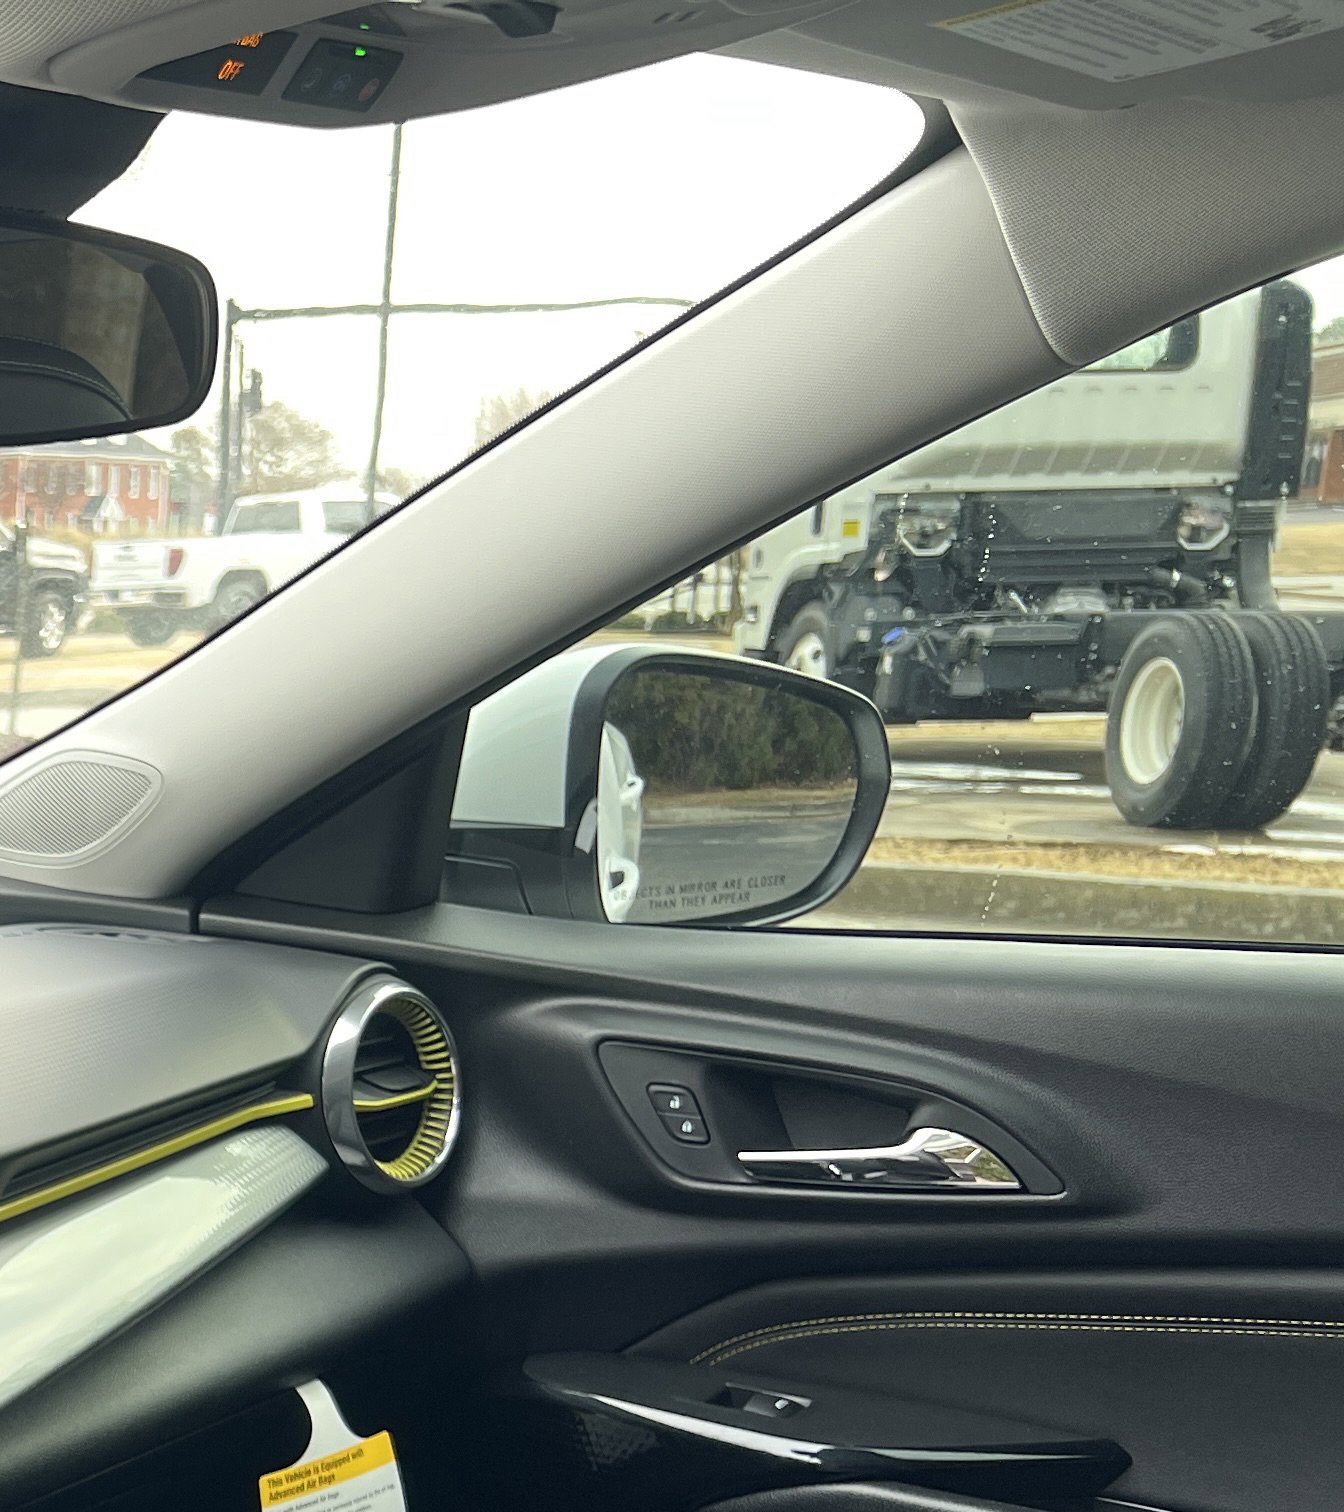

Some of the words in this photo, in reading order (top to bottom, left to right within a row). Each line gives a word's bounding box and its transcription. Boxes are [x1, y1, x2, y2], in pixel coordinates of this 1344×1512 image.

[218, 59, 244, 80] OFF
[665, 885, 675, 896] IN
[679, 881, 717, 895] MIRROR
[723, 878, 742, 890] ARE
[747, 874, 786, 889] CLOSER
[649, 897, 676, 910] THAN
[681, 894, 706, 908] THEY
[711, 891, 750, 906] APPEAR
[267, 1476, 283, 1488] This
[284, 1468, 311, 1484] Vehicle
[320, 1454, 351, 1473] Equipped
[352, 1448, 365, 1459] with
[268, 1485, 305, 1502] Advanced
[318, 1473, 336, 1487] Bags
